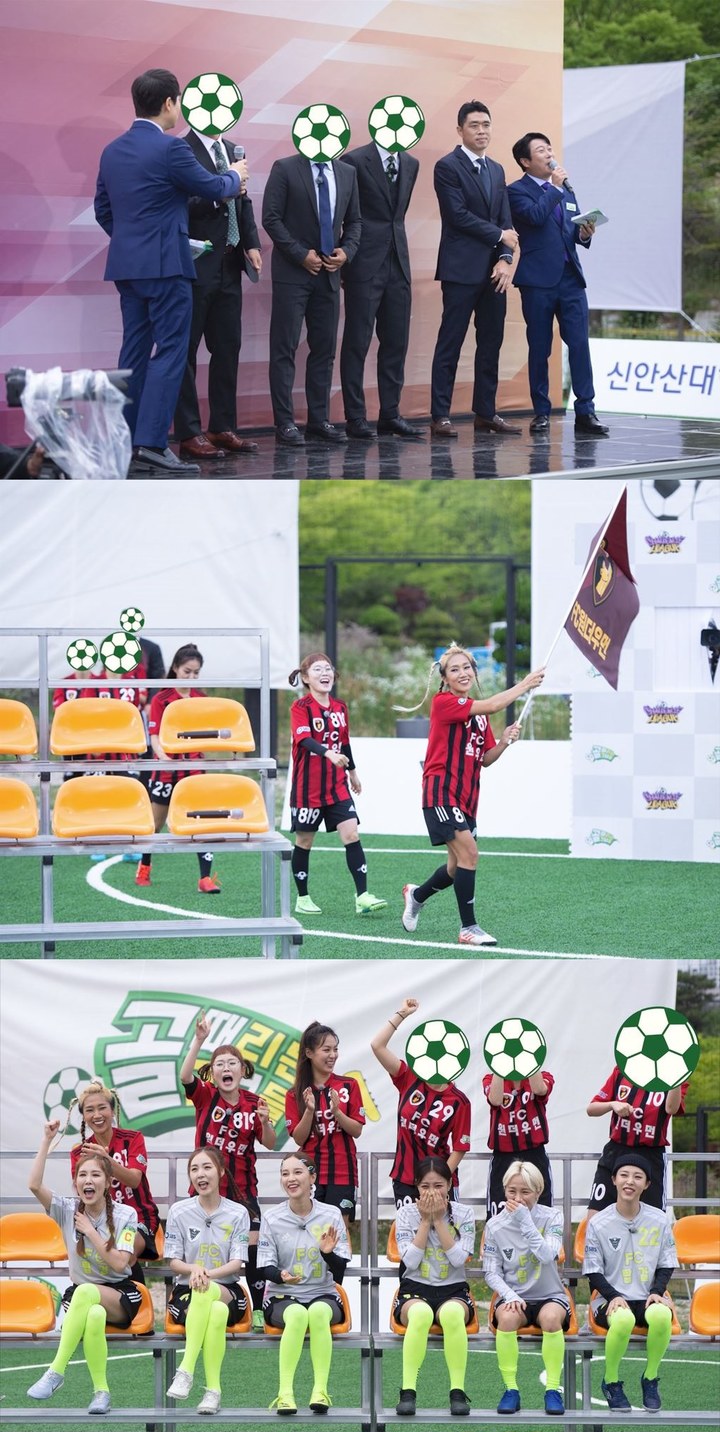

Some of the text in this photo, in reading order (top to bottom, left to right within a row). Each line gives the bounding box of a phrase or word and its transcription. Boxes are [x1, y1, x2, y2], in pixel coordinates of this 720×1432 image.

[607, 361, 720, 396] 신안산대
[322, 731, 339, 741] FC
[470, 732, 485, 745] FC
[152, 780, 173, 798] 23
[298, 807, 320, 825] 819
[428, 1100, 454, 1122] 29
[509, 1109, 527, 1123] FC
[411, 1110, 431, 1128] FC
[218, 1124, 239, 1139] FC
[613, 1116, 656, 1139] 더우먼
[124, 1233, 132, 1242] C
[220, 1222, 235, 1242] 7
[639, 1226, 660, 1247] 22
[199, 1243, 220, 1257] FC
[296, 1247, 320, 1262] FC
[424, 1247, 447, 1262] FC
[624, 1251, 645, 1266] FC
